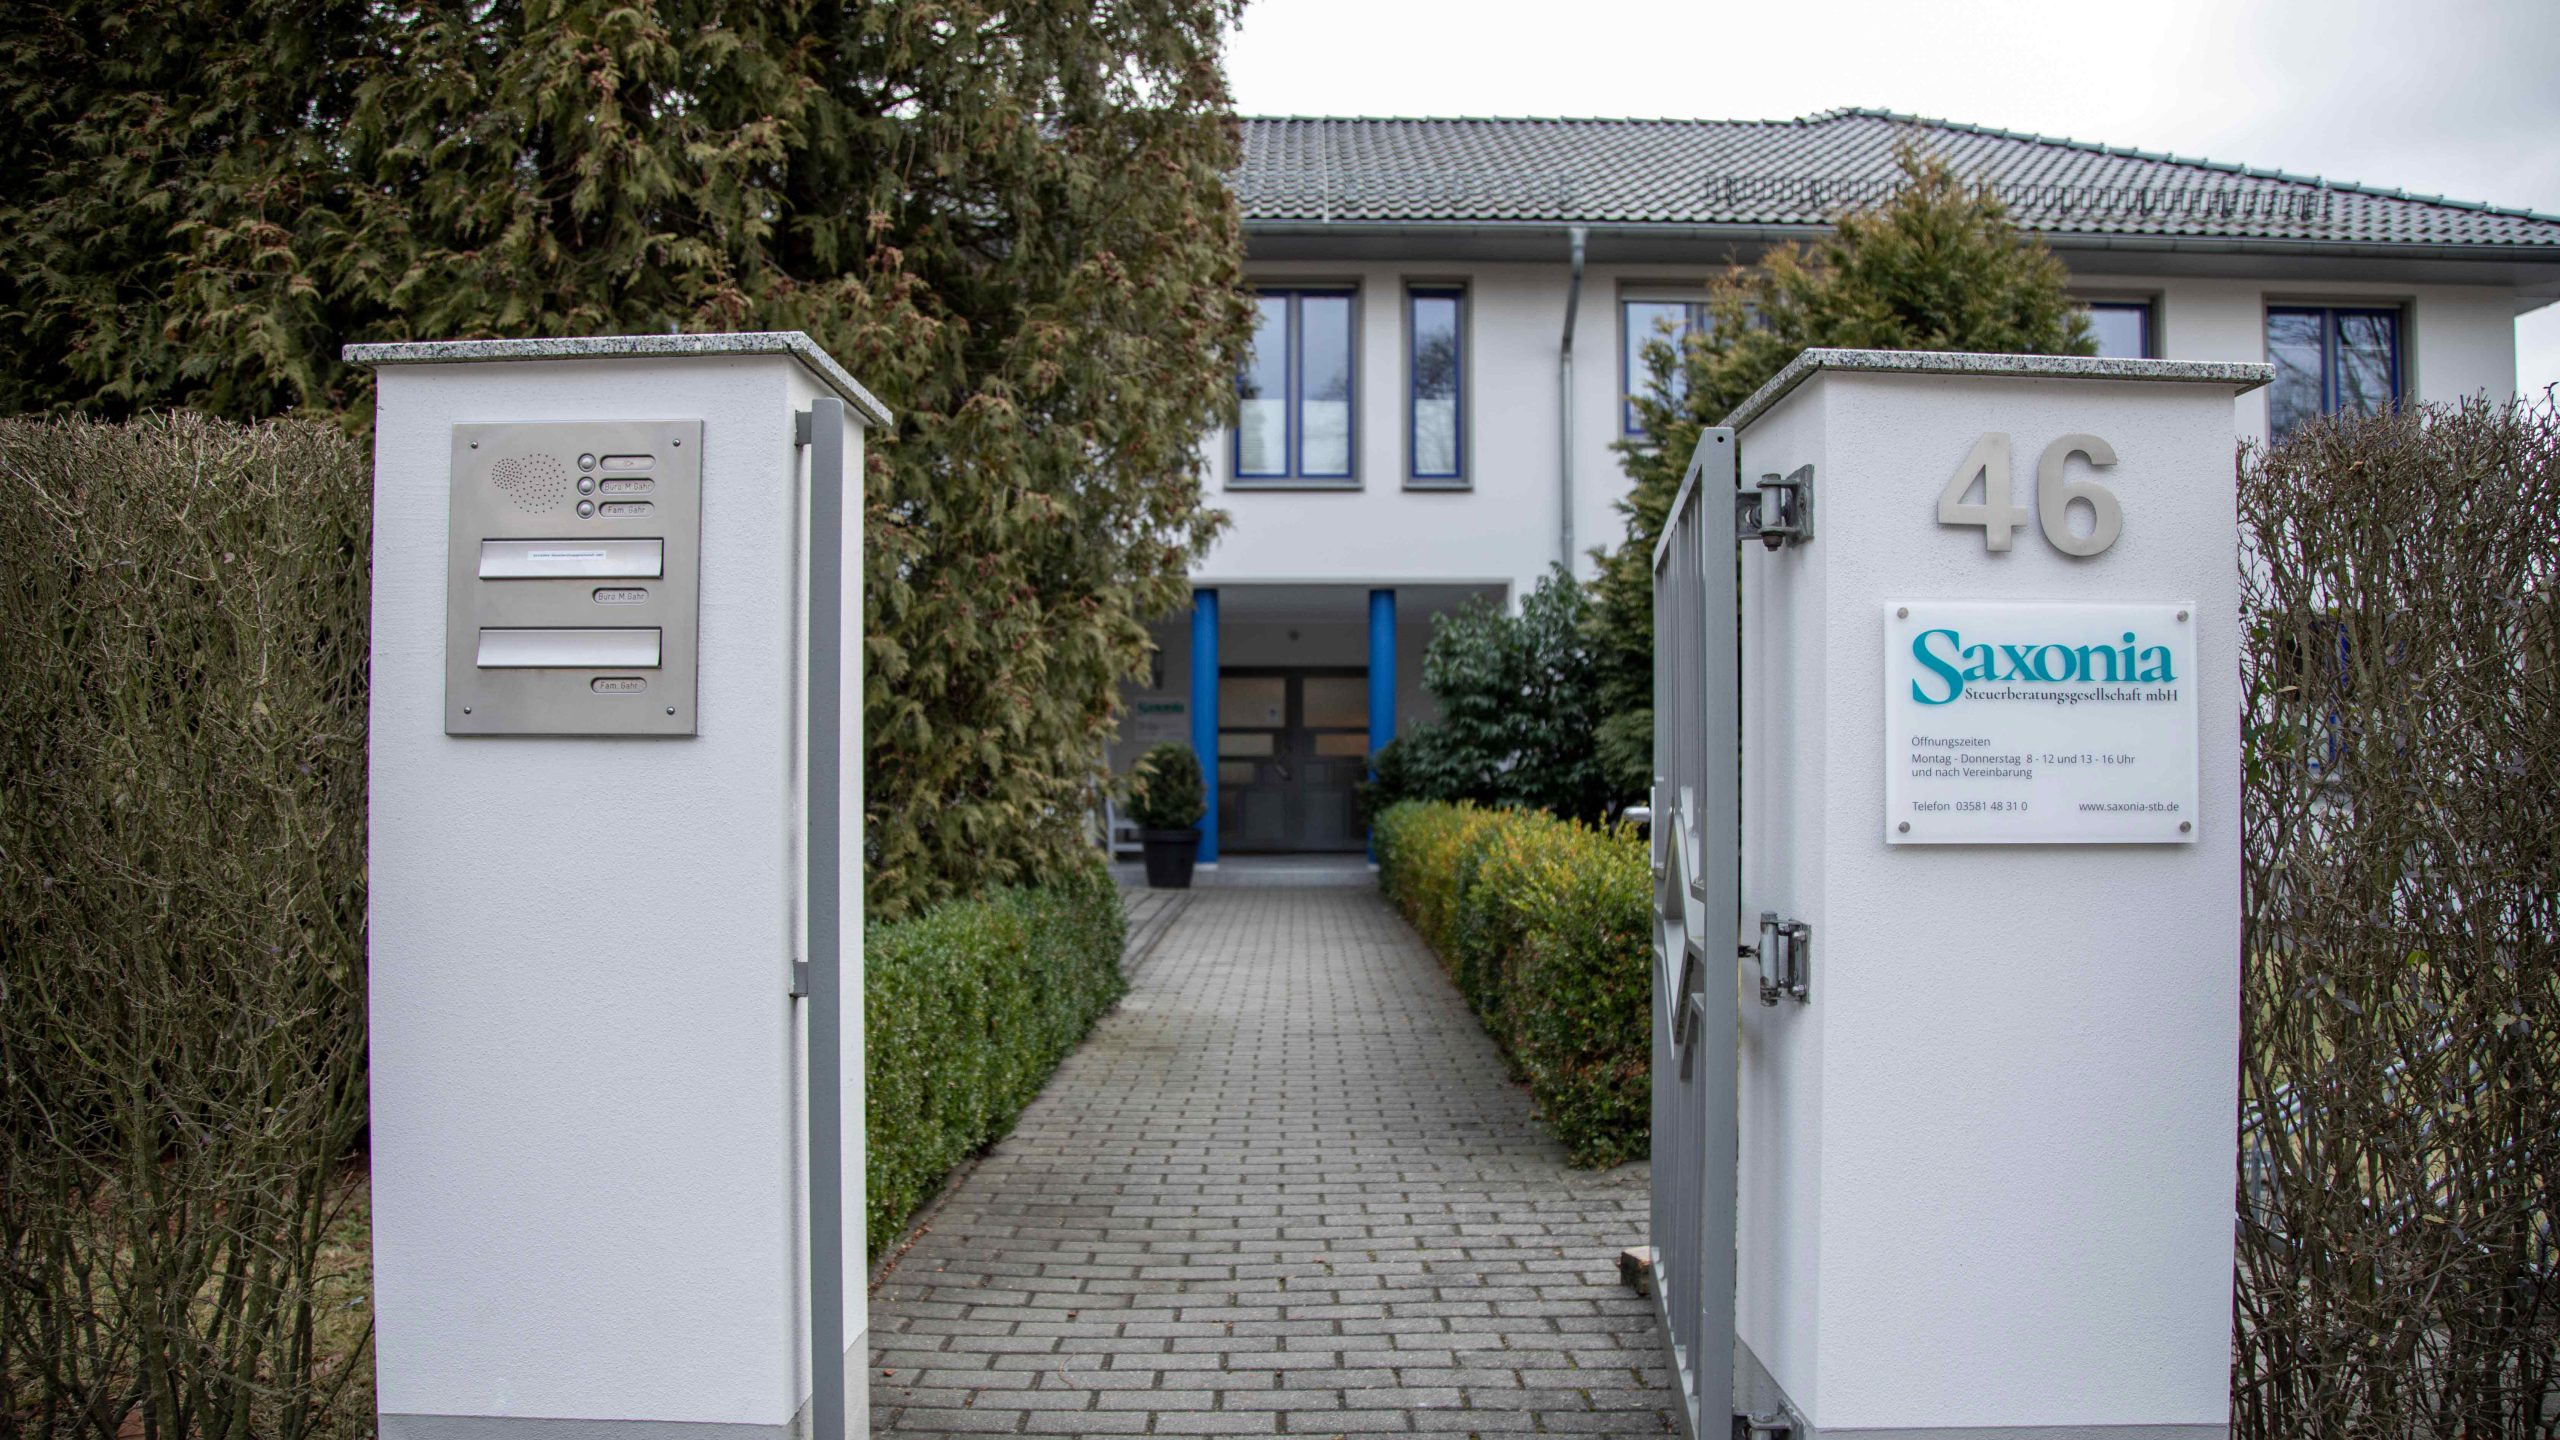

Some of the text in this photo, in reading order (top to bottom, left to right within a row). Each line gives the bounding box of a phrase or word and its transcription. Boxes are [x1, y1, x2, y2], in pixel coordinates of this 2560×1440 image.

[1937, 432, 2123, 557] 46
[1912, 629, 2178, 705] Saxonia
[620, 681, 638, 690] Gahr
[1965, 687, 2178, 704] Steuerberatungsgesellschaft mbH
[1911, 736, 1991, 749] Öffnungszeiten
[1912, 754, 1952, 766] Montag
[1961, 754, 2021, 766] Donnerstag
[2026, 754, 2033, 764] 8
[2043, 754, 2055, 764] 12
[2057, 754, 2077, 764] und
[2081, 754, 2092, 764] 13
[2102, 754, 2114, 764] 16
[2117, 754, 2136, 764] Uhr
[1912, 768, 2033, 779] und nach Vereinbarung
[1912, 801, 2028, 811] Telefon 03581 48 31 0
[2078, 802, 2180, 812] www.saxonia-stb.de
